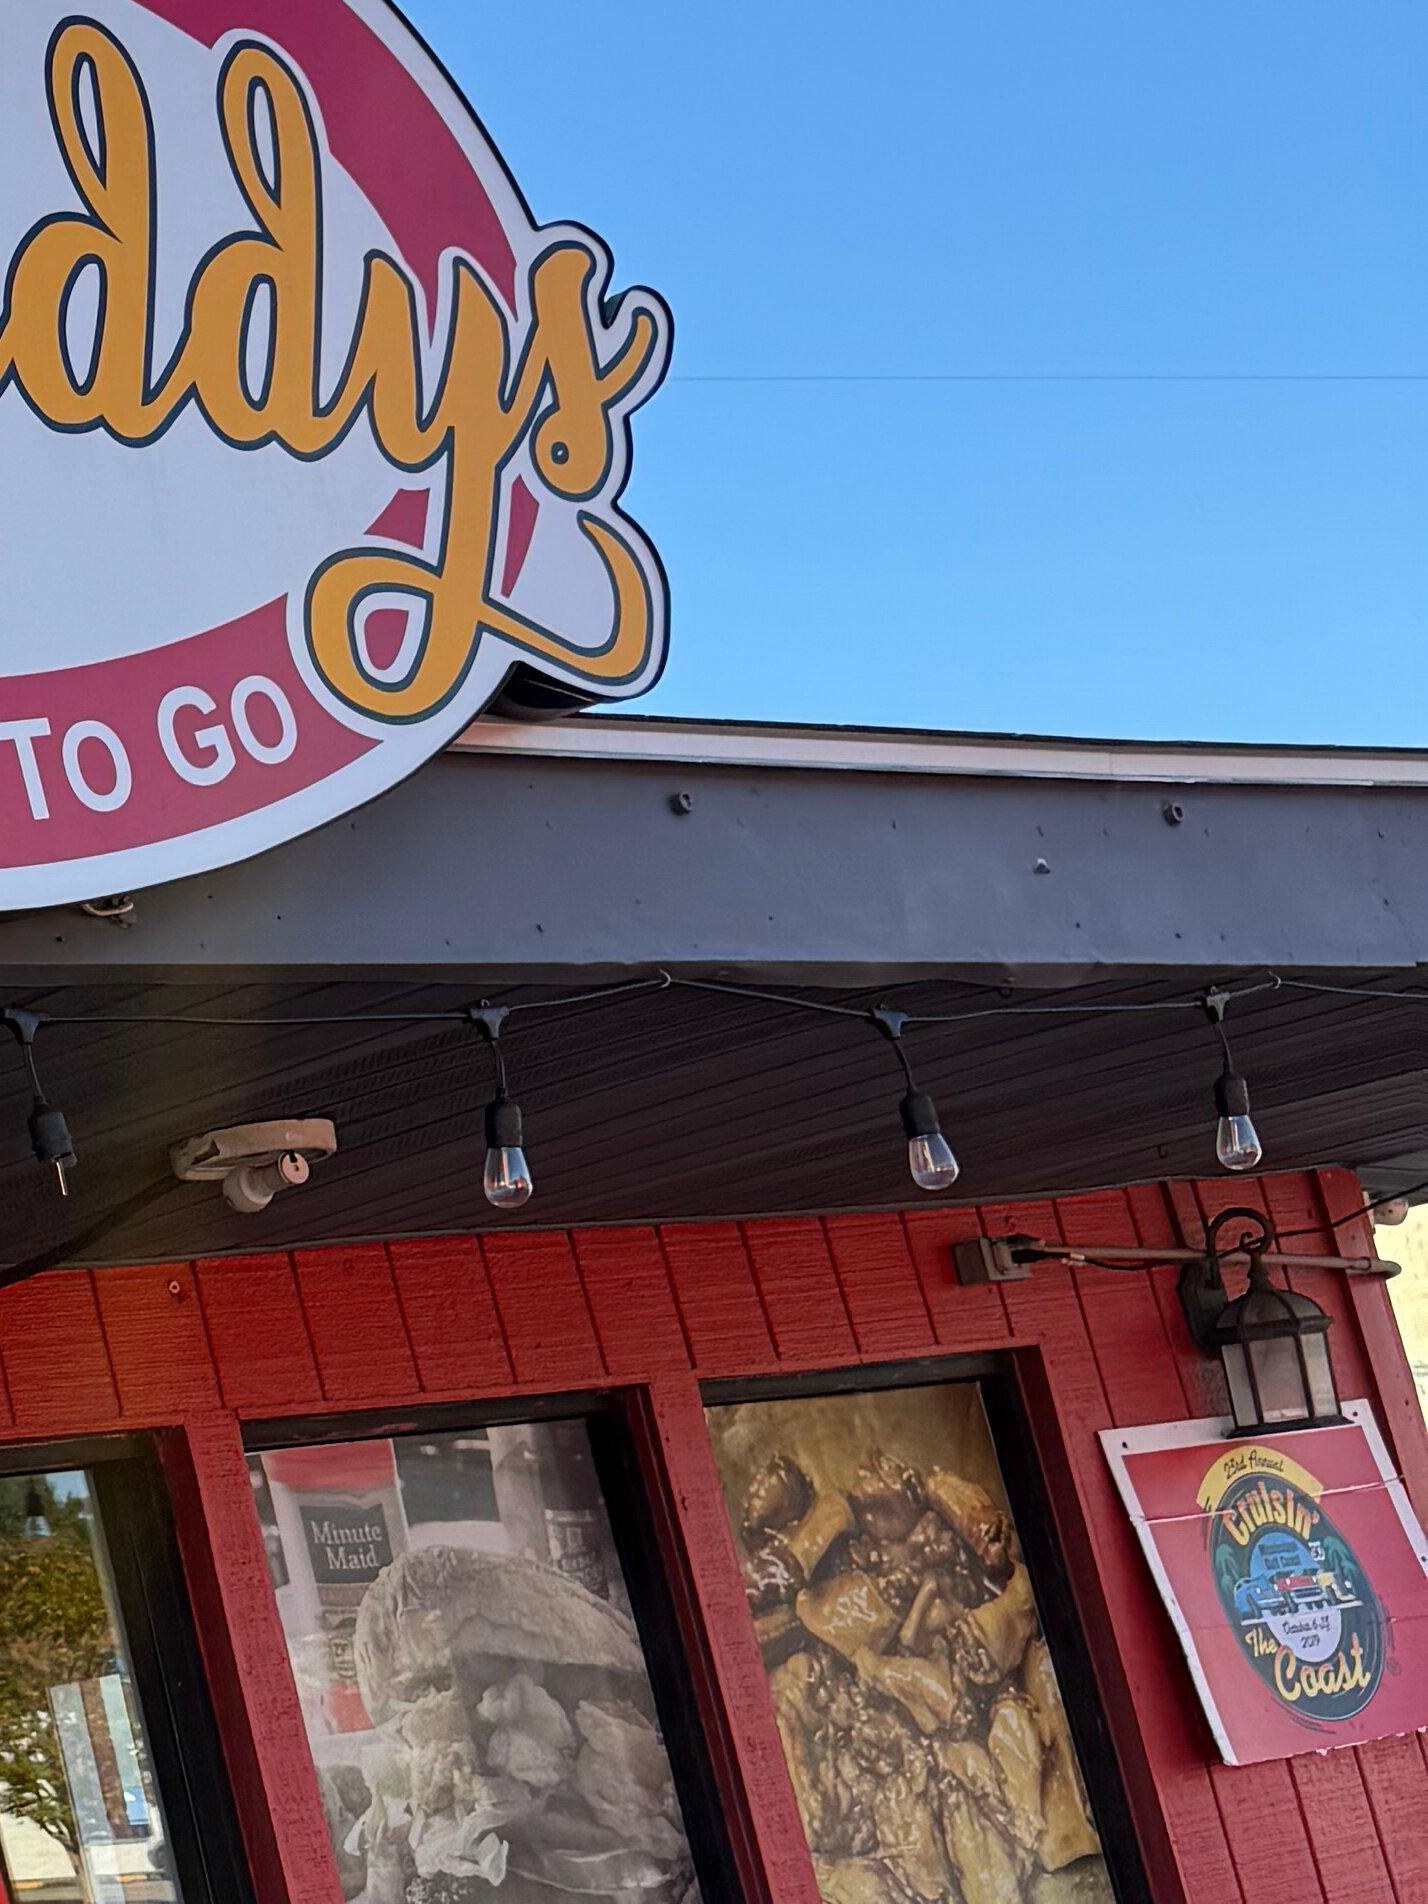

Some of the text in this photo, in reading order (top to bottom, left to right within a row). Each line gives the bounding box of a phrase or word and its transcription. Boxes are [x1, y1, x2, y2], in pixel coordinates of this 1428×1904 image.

[158, 674, 298, 786] GO
[310, 1520, 382, 1545] Minute
[326, 1544, 379, 1570] Maid
[1245, 1627, 1278, 1659] The
[1274, 1632, 1371, 1702] Coast
